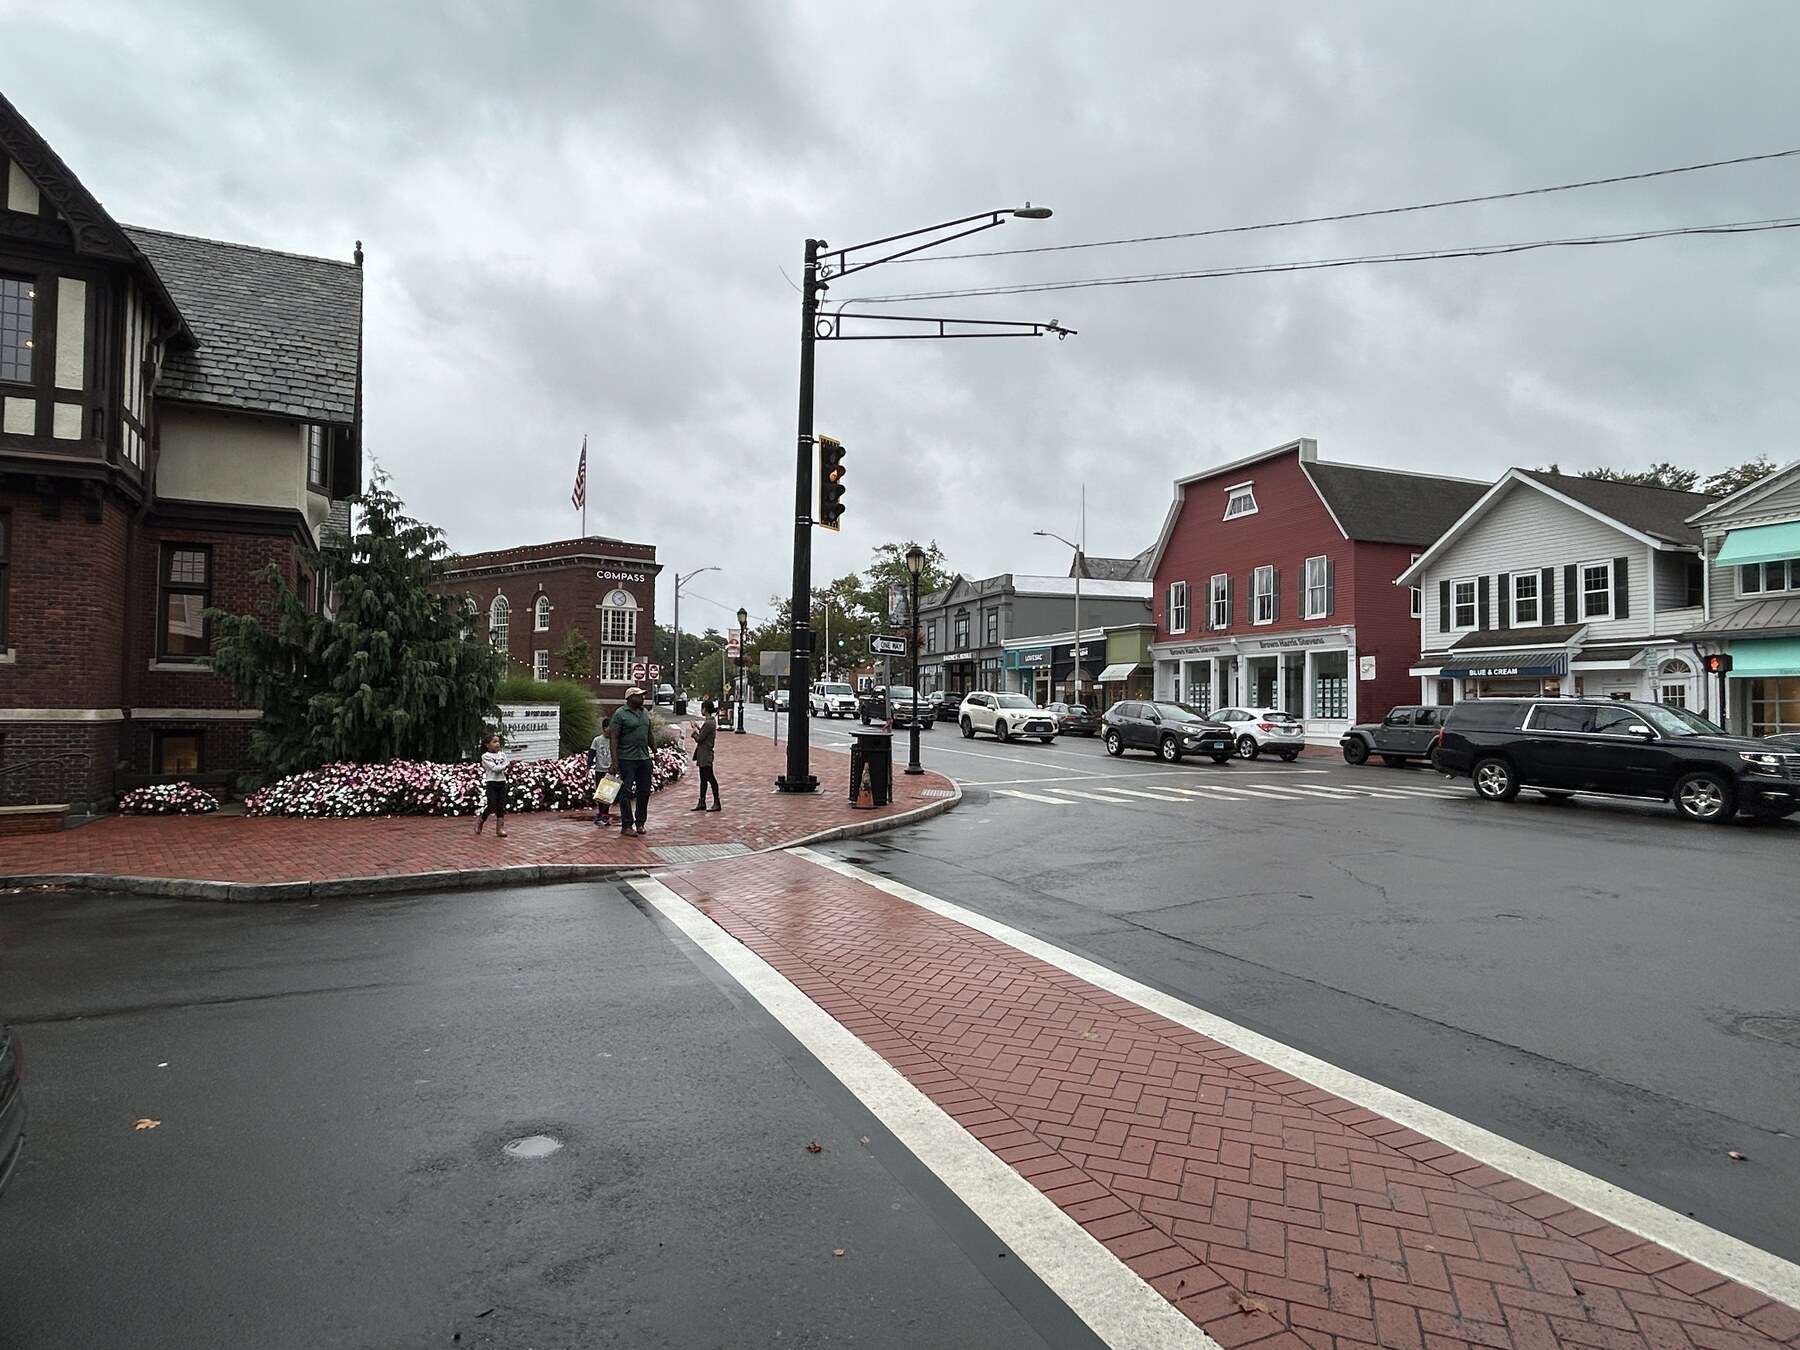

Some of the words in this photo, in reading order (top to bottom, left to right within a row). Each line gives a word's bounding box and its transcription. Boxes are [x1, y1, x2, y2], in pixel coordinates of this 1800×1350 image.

[597, 571, 645, 582] COMPASS
[880, 641, 891, 650] ONE
[892, 642, 903, 651] WAY
[1259, 640, 1279, 649] Brown
[1280, 638, 1298, 648] Harris
[1298, 637, 1325, 646] Stevens
[1169, 648, 1185, 656] Brown
[1199, 645, 1220, 654] Stevens
[1024, 653, 1043, 662] LOVESAC
[1493, 668, 1518, 676] CREAM
